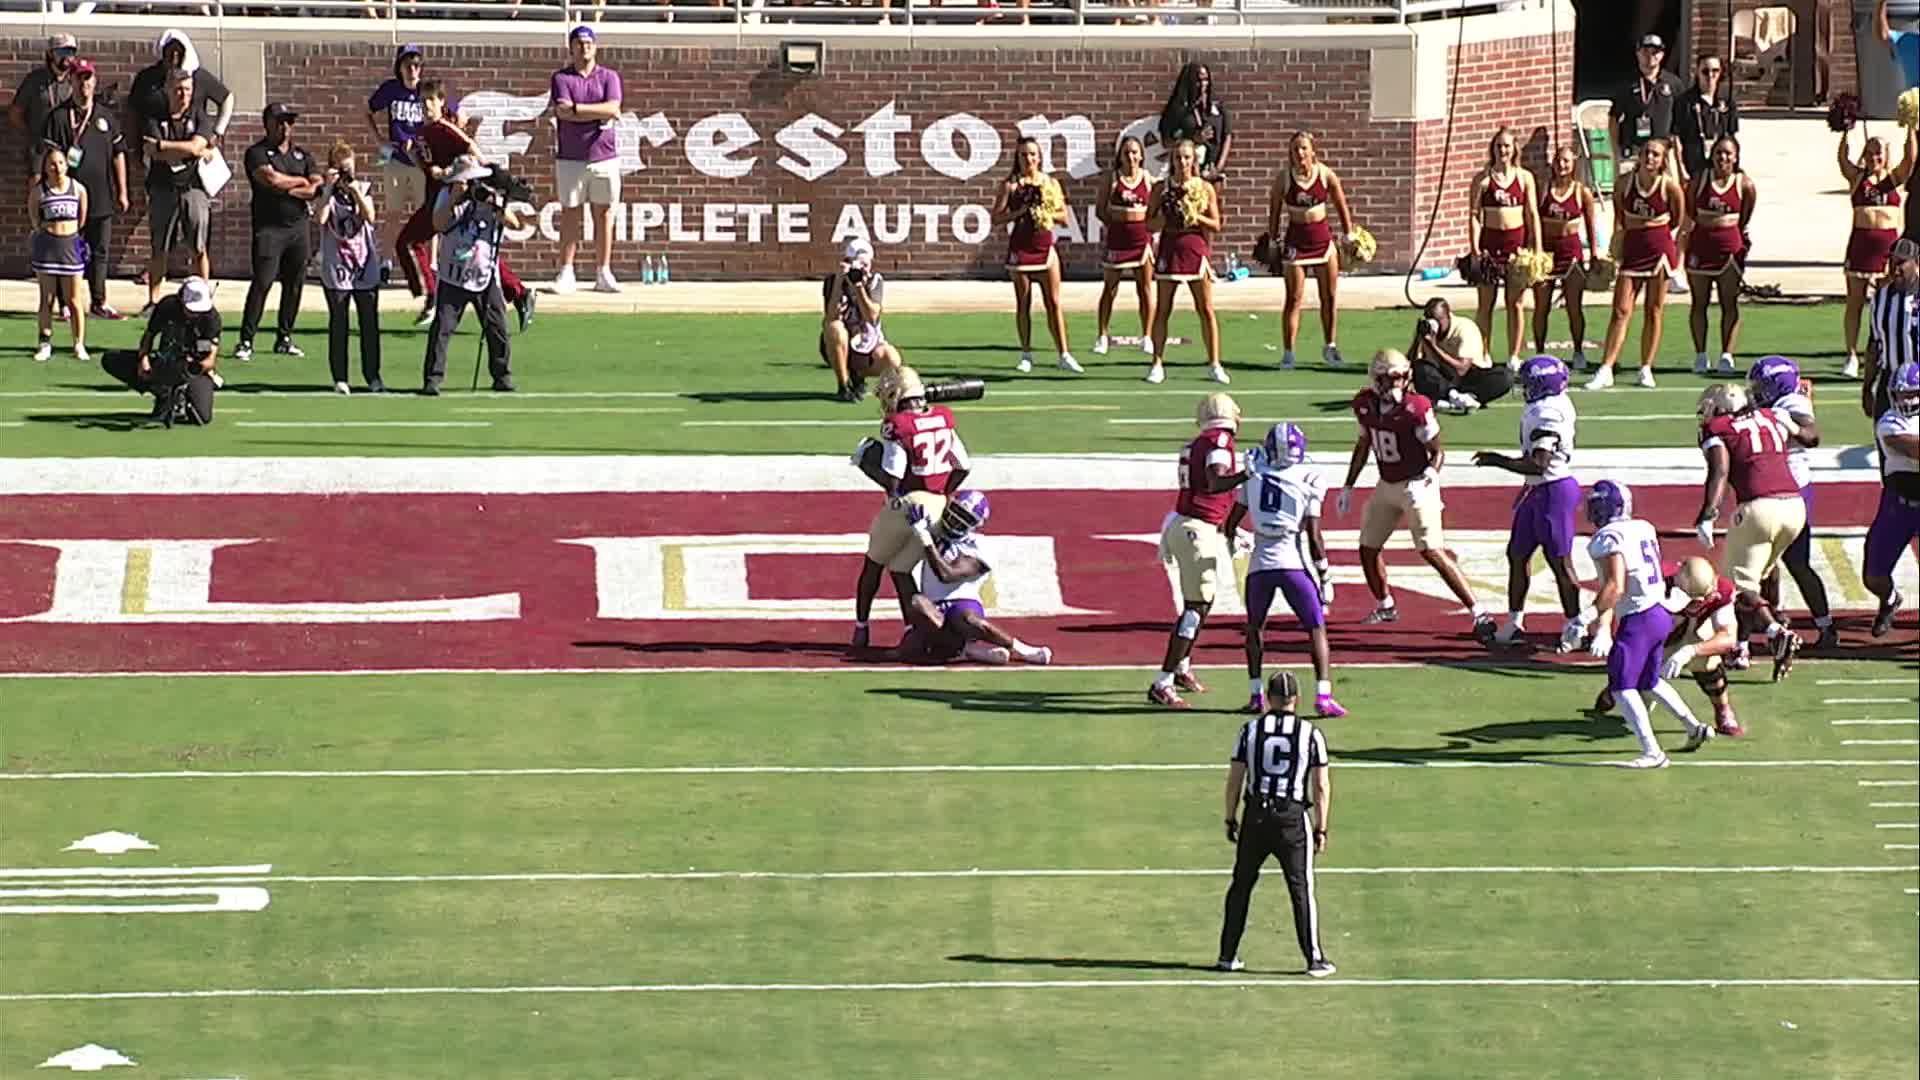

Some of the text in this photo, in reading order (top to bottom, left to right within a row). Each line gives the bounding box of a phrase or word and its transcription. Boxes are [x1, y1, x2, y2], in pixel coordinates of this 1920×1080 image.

[456, 90, 1169, 181] Frestone
[831, 204, 991, 244] AUTO
[911, 428, 953, 475] 32
[1369, 427, 1401, 462] 18
[1262, 735, 1292, 775] C
